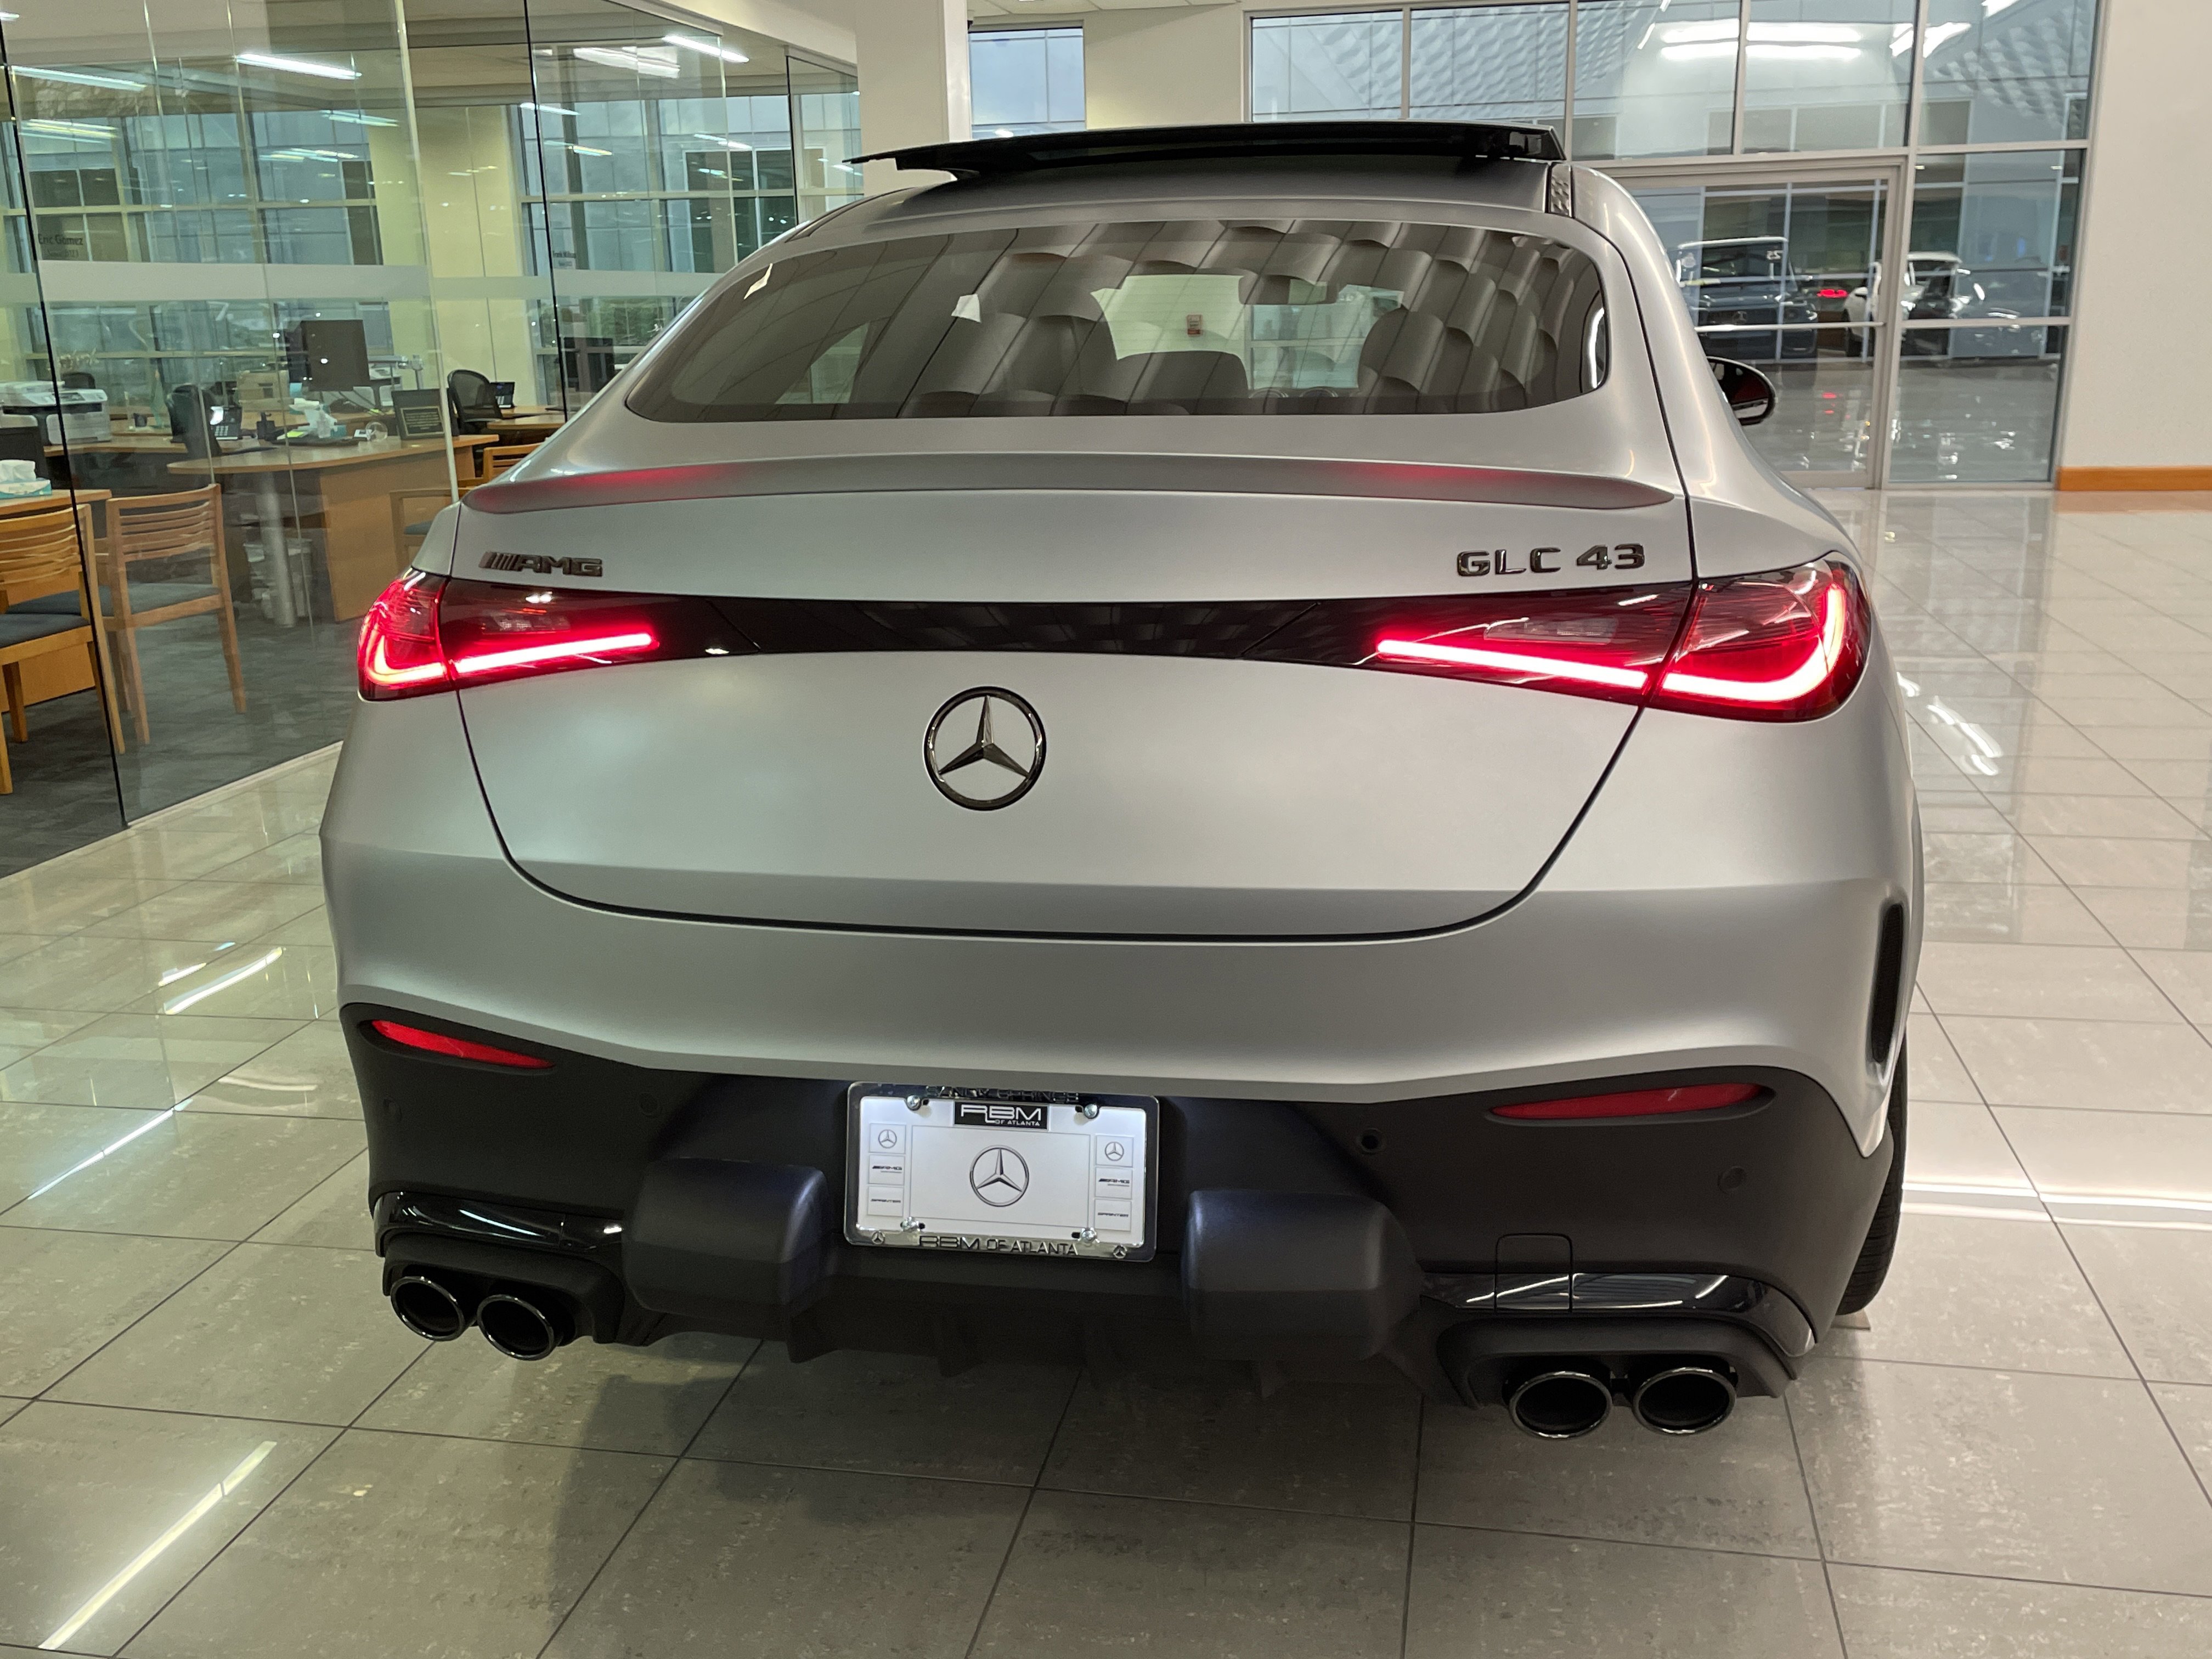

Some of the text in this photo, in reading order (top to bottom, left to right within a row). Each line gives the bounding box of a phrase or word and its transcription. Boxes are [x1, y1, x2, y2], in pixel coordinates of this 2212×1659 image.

[1457, 543, 1645, 577] GLC 43
[961, 1104, 1041, 1124] RBM
[919, 1235, 1079, 1256] RBM OF ATLANTA
